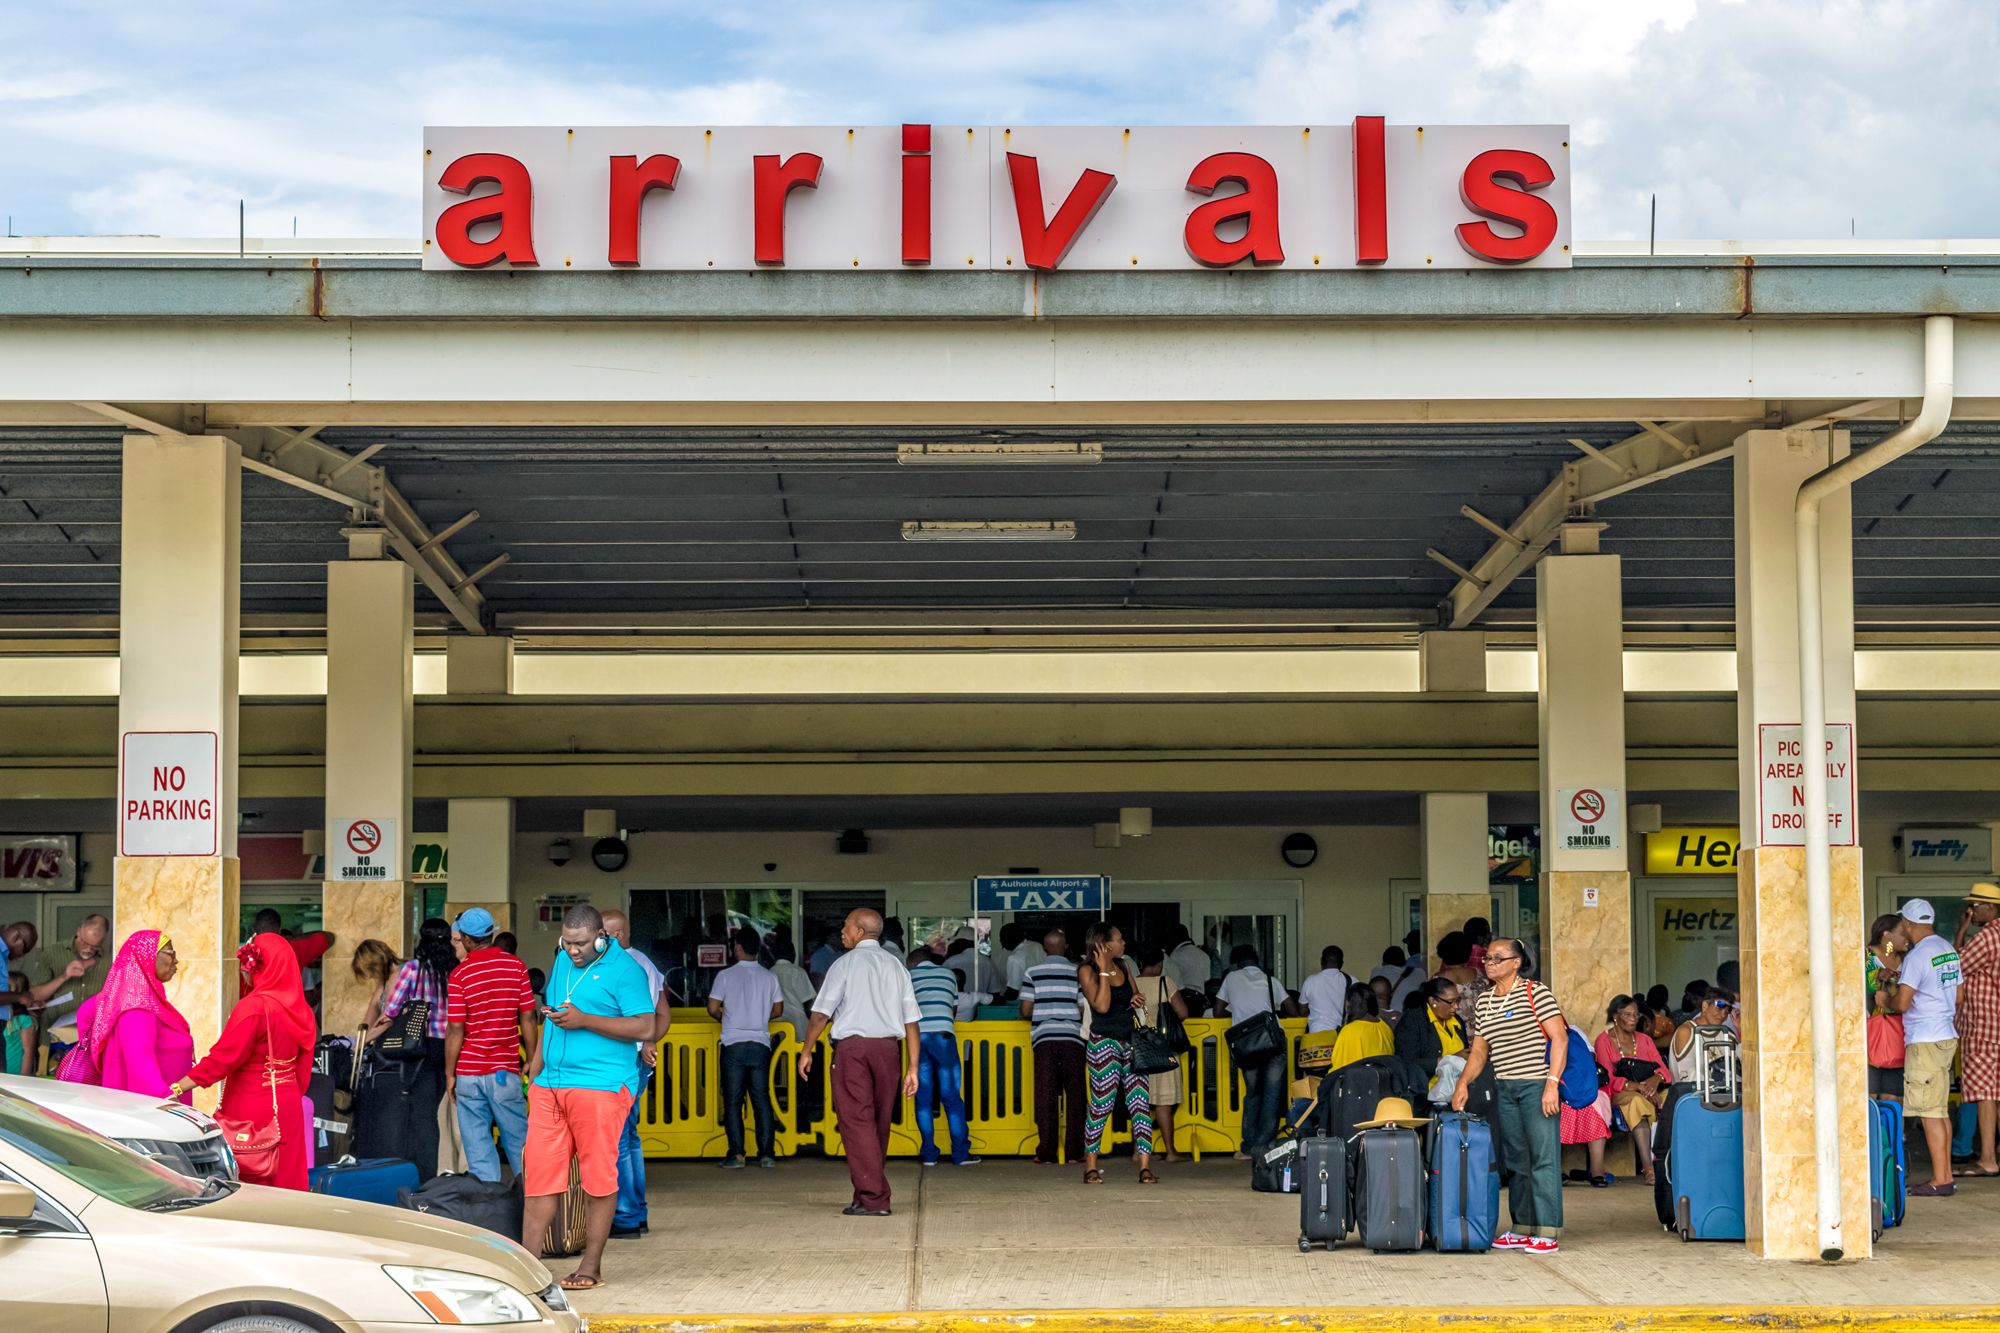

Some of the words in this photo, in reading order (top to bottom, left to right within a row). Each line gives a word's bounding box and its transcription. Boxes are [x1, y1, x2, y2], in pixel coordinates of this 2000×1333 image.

[435, 115, 1559, 271] arrivals
[1778, 741, 1803, 756] PIC
[153, 766, 186, 792] NO
[127, 799, 211, 821] PARKING
[1582, 825, 1595, 835] NO
[1567, 836, 1611, 846] SMOKING
[1911, 839, 1969, 862] Thrifty
[0, 848, 63, 879] VIS
[357, 856, 370, 866] NO
[342, 867, 386, 877] SMOKING
[1001, 880, 1048, 888] Authorised
[1049, 880, 1081, 889] Airport
[996, 890, 1085, 909] TAXI
[1663, 908, 1736, 931] Hertz
